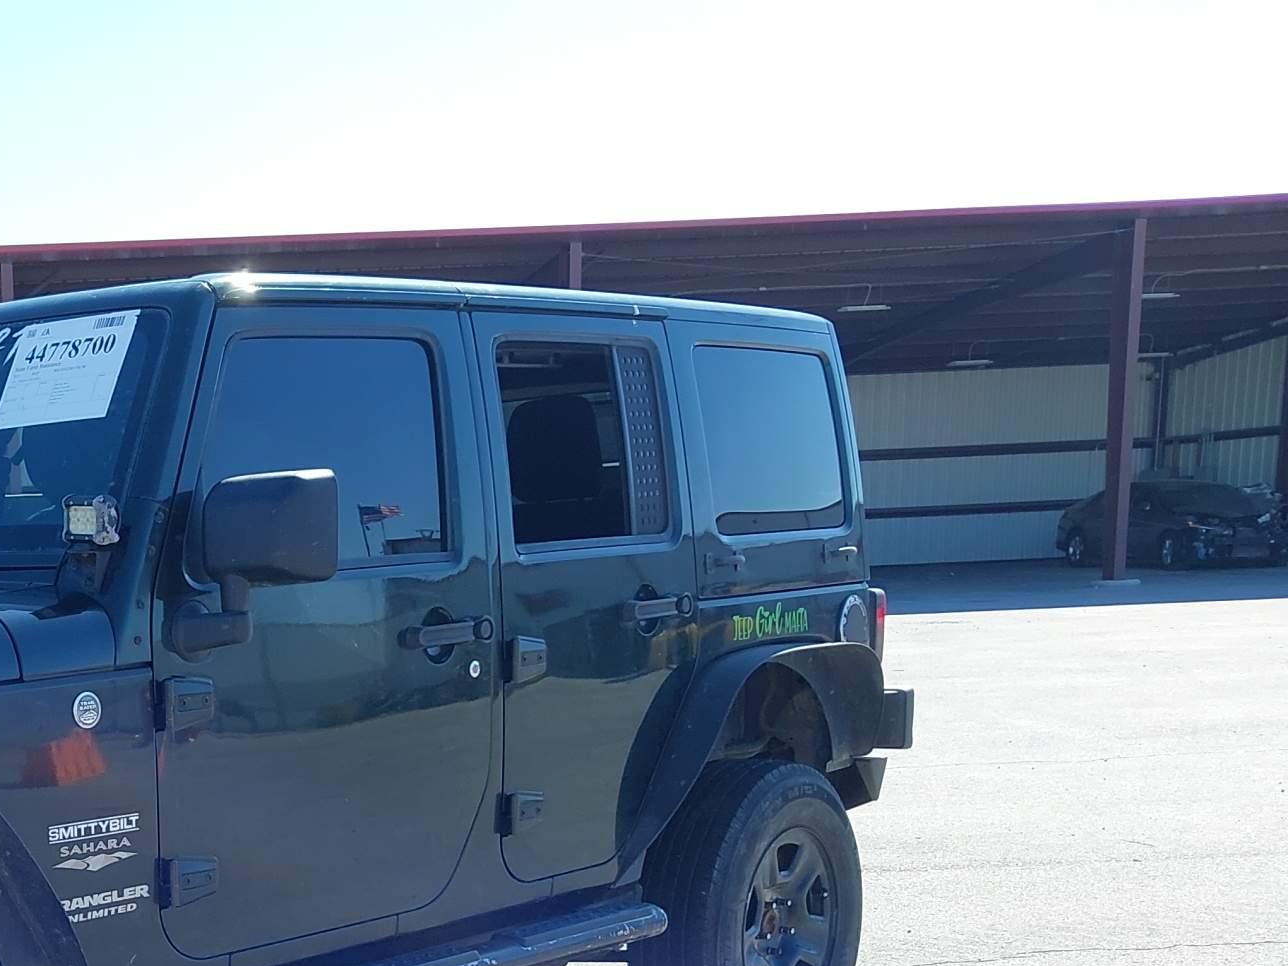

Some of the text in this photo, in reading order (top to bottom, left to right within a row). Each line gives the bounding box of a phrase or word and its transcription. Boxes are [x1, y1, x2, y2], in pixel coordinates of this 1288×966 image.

[25, 333, 117, 364] 44778700
[756, 602, 784, 637] Girl
[48, 815, 140, 842] SMITTYBILT
[59, 836, 132, 857] SAHARA
[60, 884, 150, 912] RANGLER
[67, 902, 138, 923] NLIMITED
